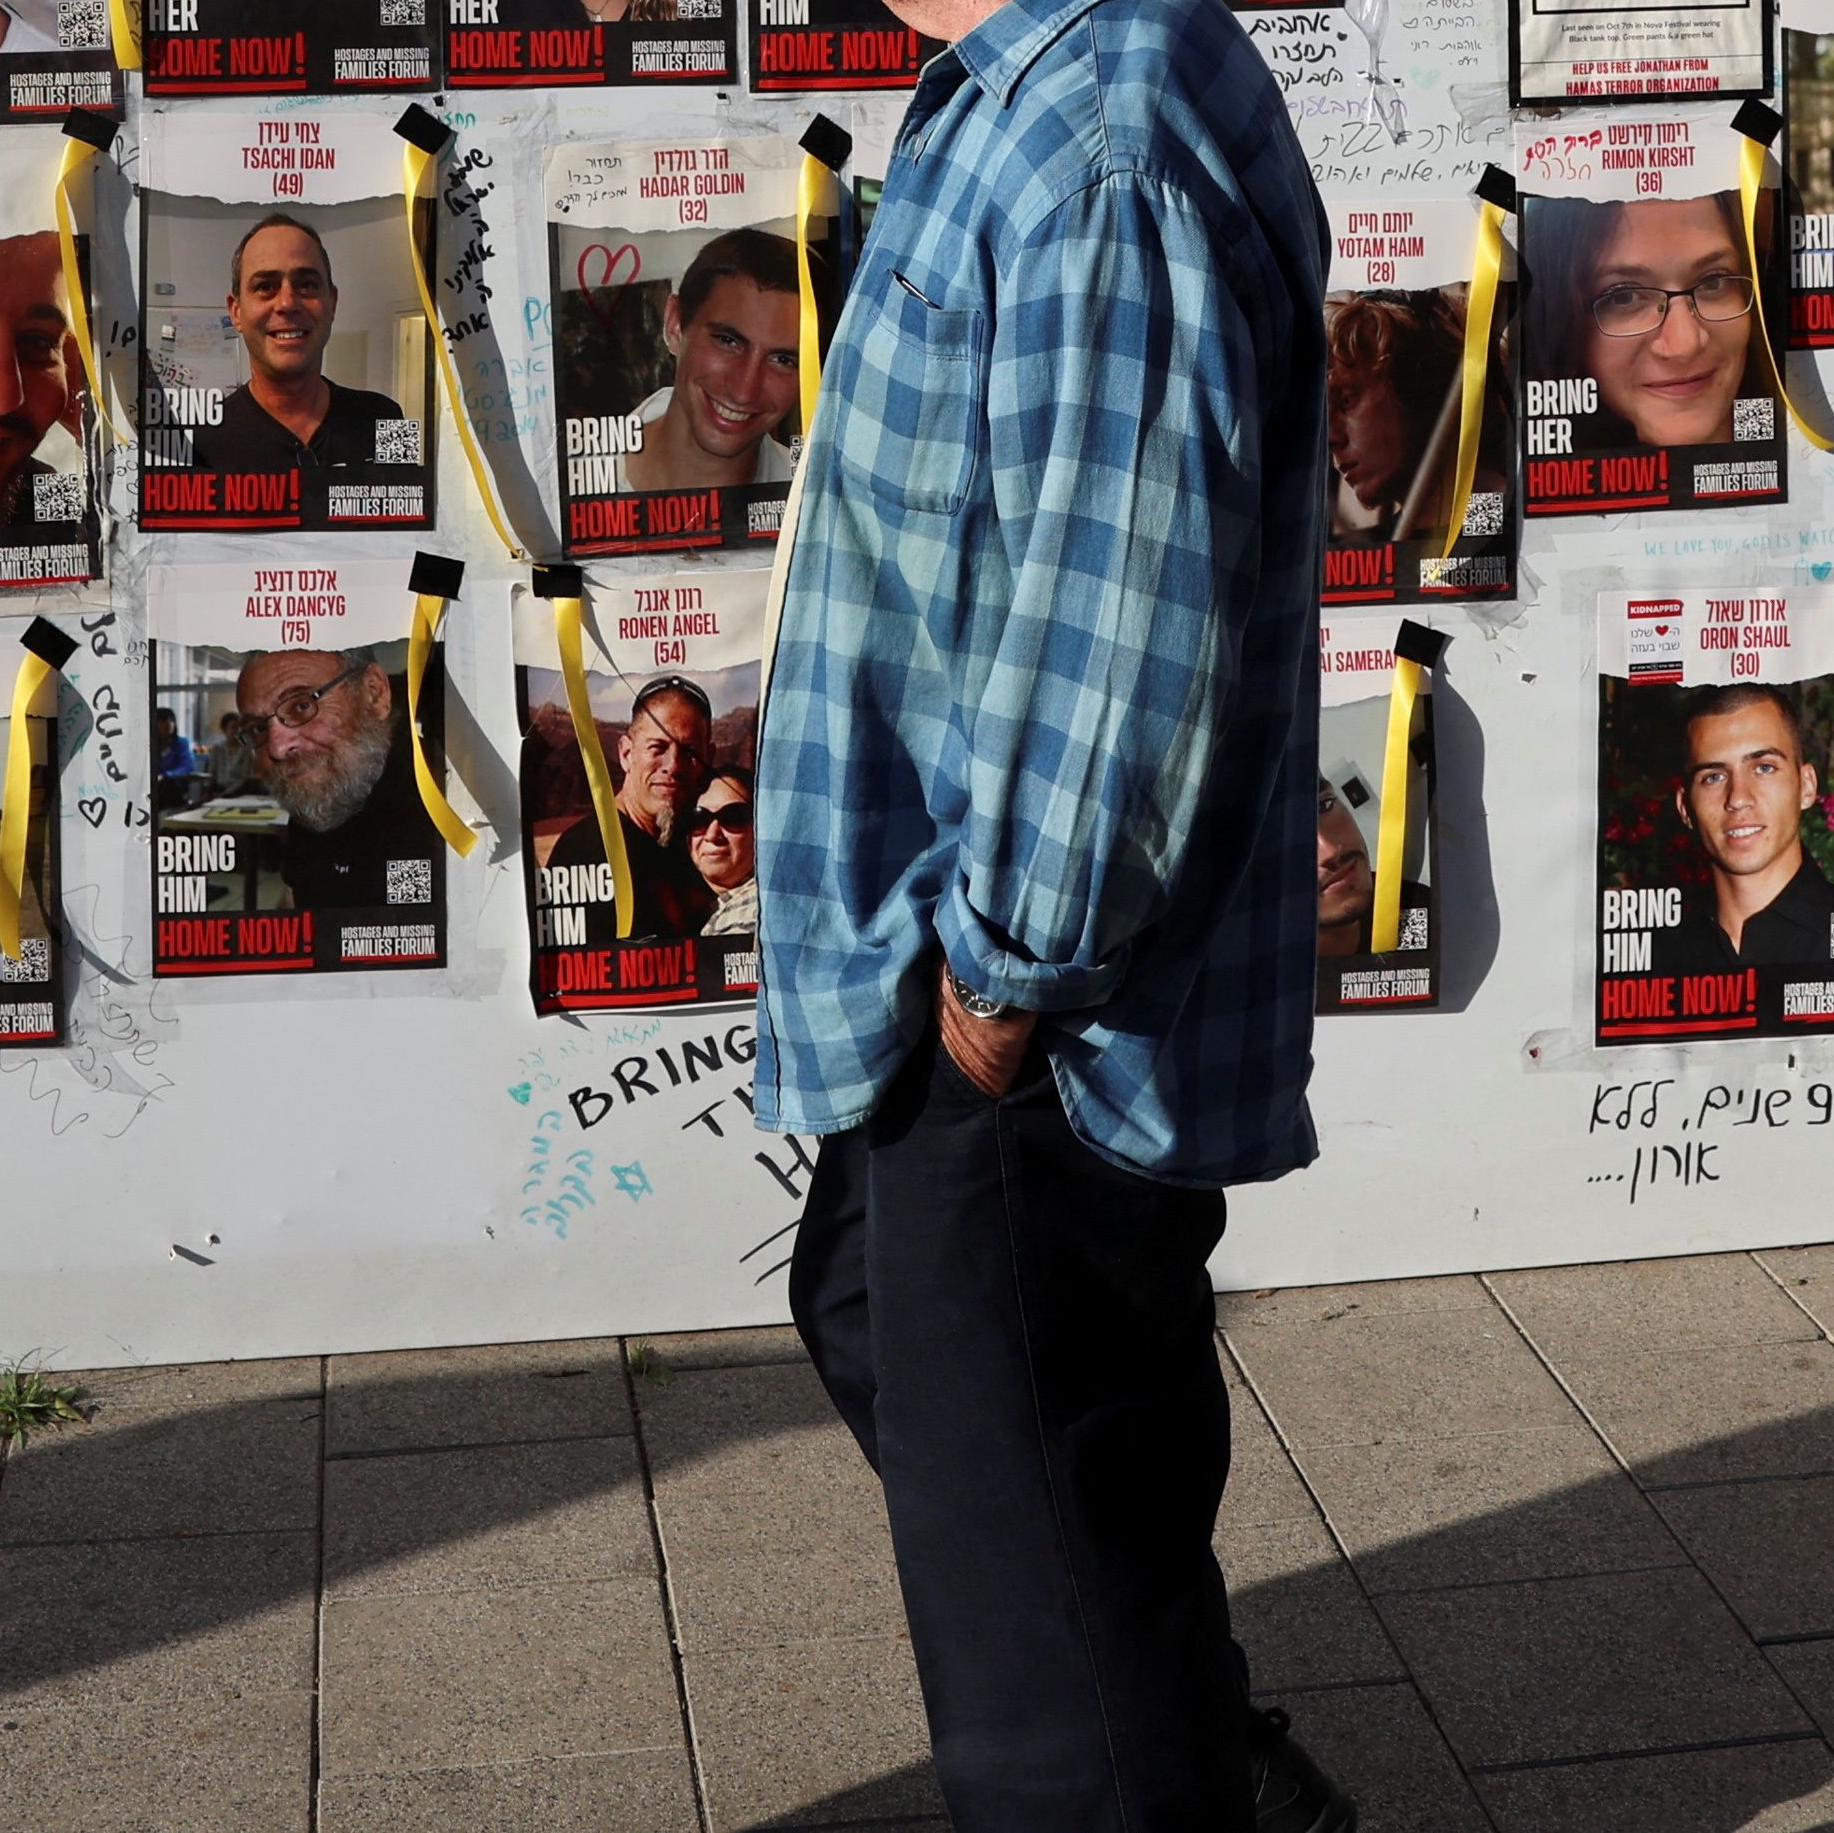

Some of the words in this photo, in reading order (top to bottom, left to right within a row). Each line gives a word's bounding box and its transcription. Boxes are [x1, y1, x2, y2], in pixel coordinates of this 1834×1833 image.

[1573, 63, 1594, 75] HELP
[1597, 62, 1608, 73] US
[1611, 61, 1632, 73] FREE
[1635, 60, 1681, 73] JONATHAN
[1684, 59, 1708, 71] FROM
[1567, 82, 1602, 95] HAMAS
[1605, 80, 1642, 94] TERROR
[1646, 77, 1719, 93] ORGANIZATION
[243, 148, 294, 168] TSACHI
[301, 149, 334, 168] IDAN
[1603, 149, 1644, 168] RIMON
[1649, 147, 1694, 166] KIRSHT
[641, 176, 688, 197] HADAR
[695, 174, 744, 194] GOLDIN
[680, 200, 707, 222] (32)
[1339, 238, 1384, 257] YOTAM
[1390, 238, 1423, 256] HAIM
[1645, 542, 1665, 555] WE
[1675, 540, 1704, 555] LOVE
[1743, 536, 1769, 549] GOD
[1776, 534, 1790, 548] IS
[620, 617, 667, 638] RONEN
[674, 614, 718, 635] ANGEL
[1702, 627, 1737, 649] ORON
[1744, 627, 1790, 647] SHAUL
[569, 1023, 757, 1131] BRING
[1589, 1080, 1675, 1133] ללא
